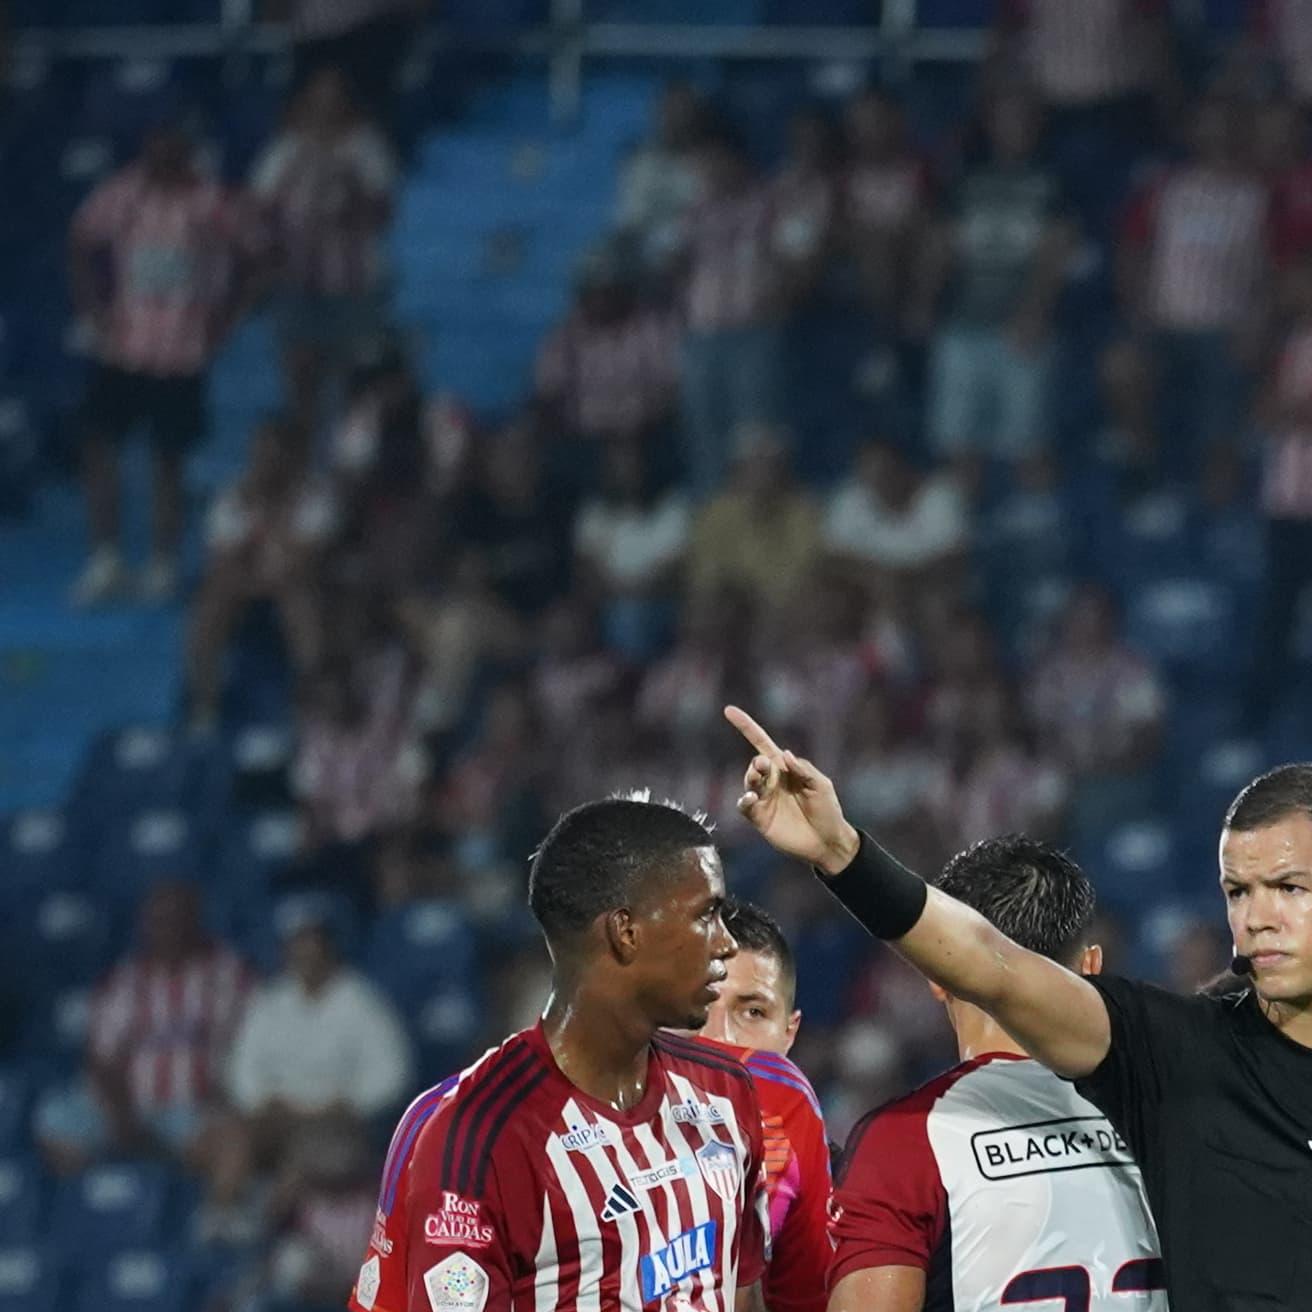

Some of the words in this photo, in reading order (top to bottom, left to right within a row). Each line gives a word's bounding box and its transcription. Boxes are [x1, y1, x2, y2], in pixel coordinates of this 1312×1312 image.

[442, 1190, 480, 1216] RON
[424, 1214, 493, 1243] CALDAS
[652, 1226, 710, 1297] AULA
